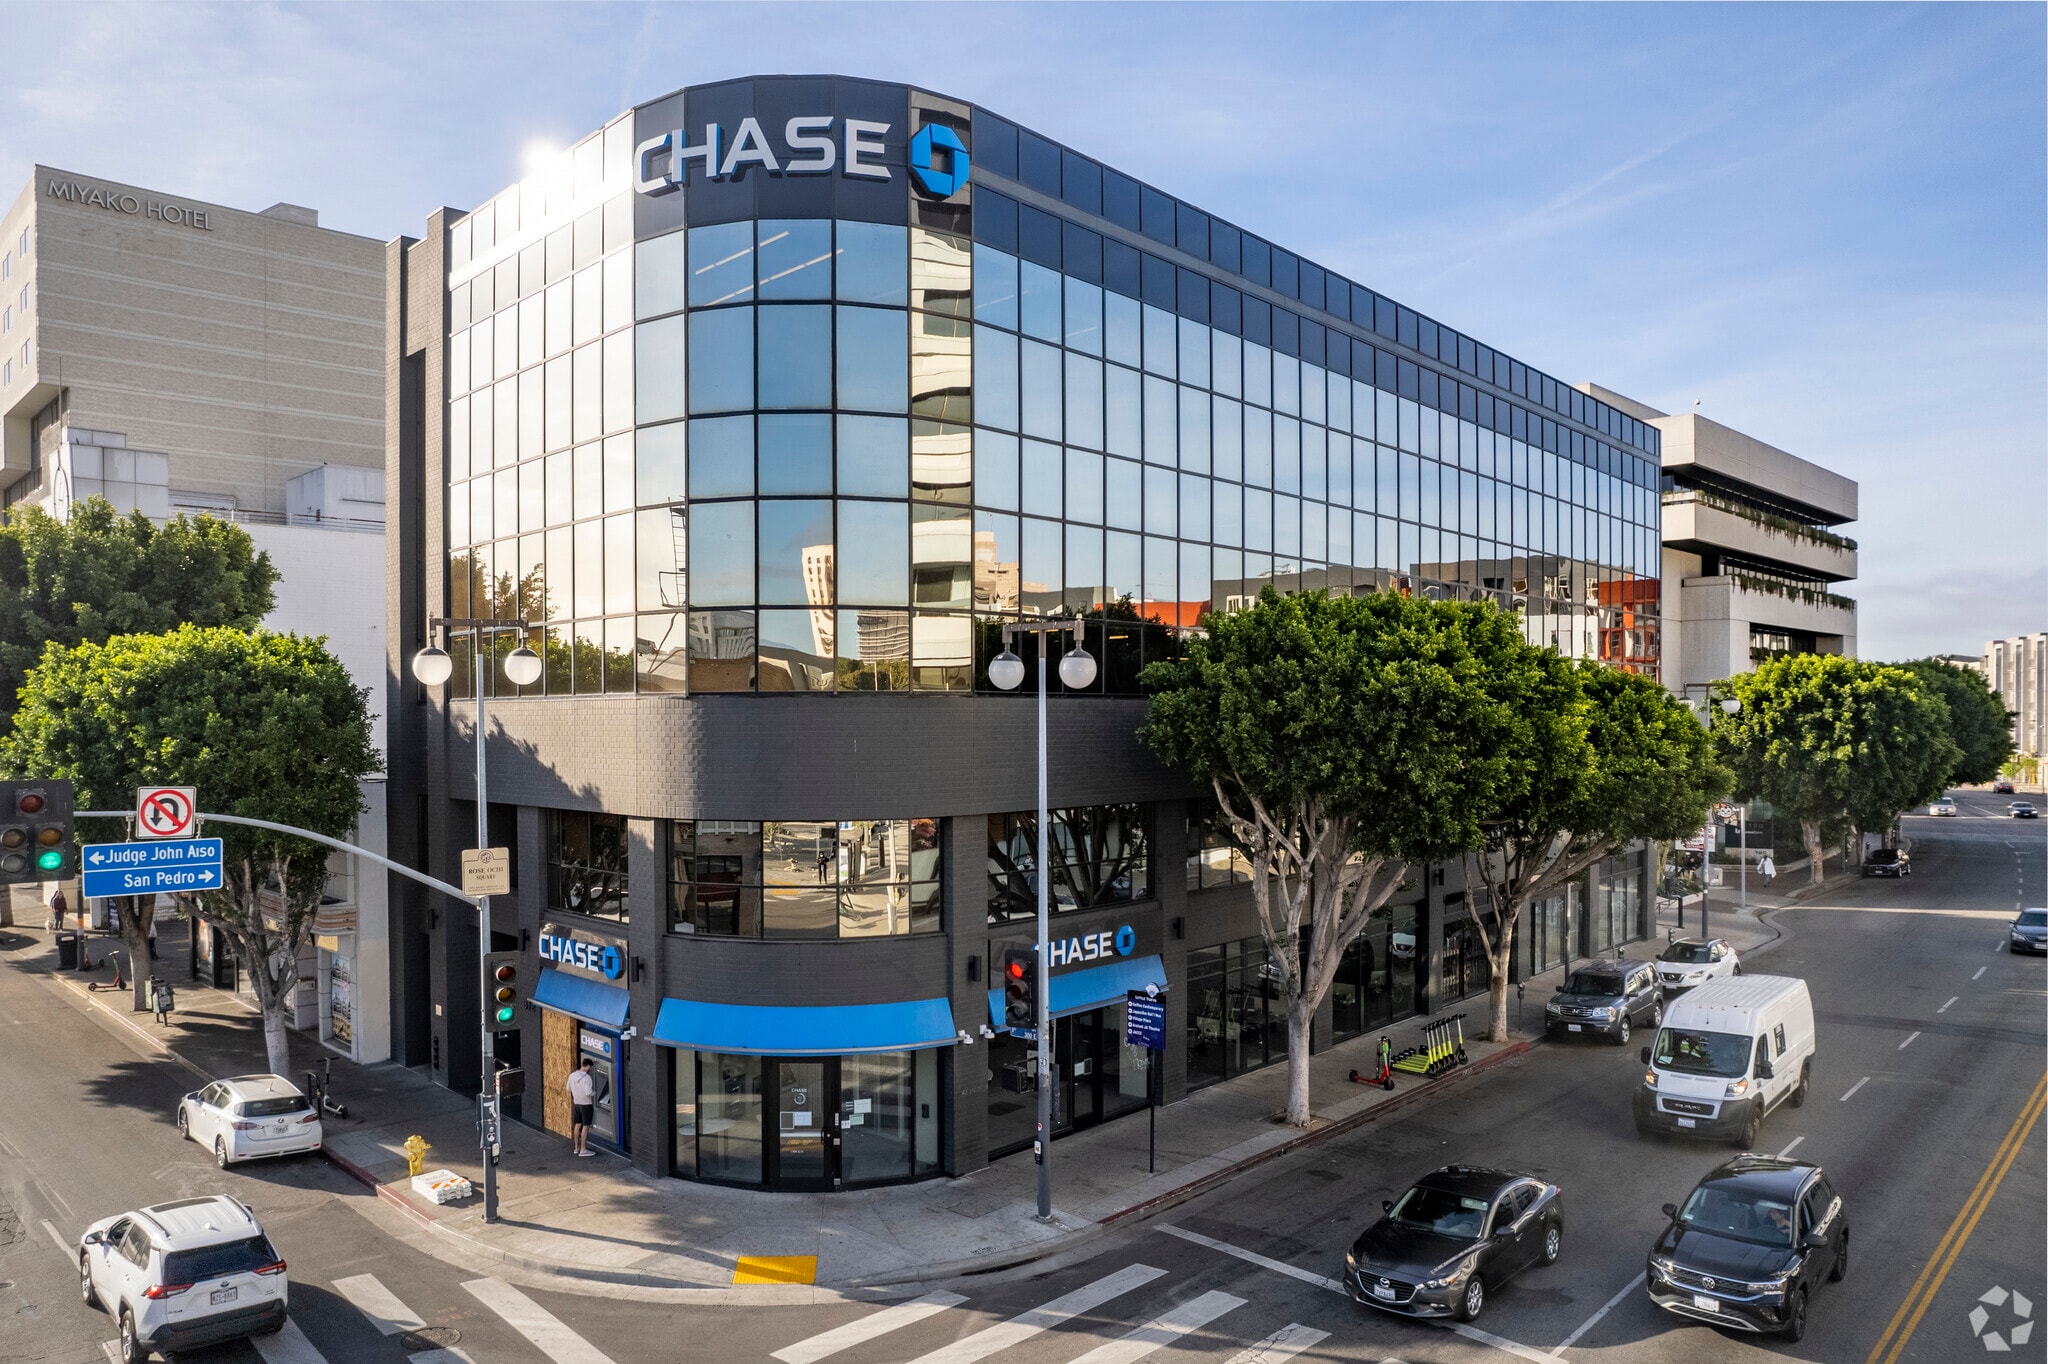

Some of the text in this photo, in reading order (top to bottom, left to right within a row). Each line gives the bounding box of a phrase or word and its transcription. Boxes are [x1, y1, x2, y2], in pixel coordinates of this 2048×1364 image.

[633, 115, 892, 195] CHASE
[48, 179, 214, 231] MIYAKO HOTEL
[105, 849, 147, 865] Judge
[151, 846, 183, 860] John
[124, 871, 195, 888] San Pedro
[539, 933, 600, 973] CHASE
[1034, 931, 1113, 968] HASE
[580, 1034, 604, 1051] CHASE
